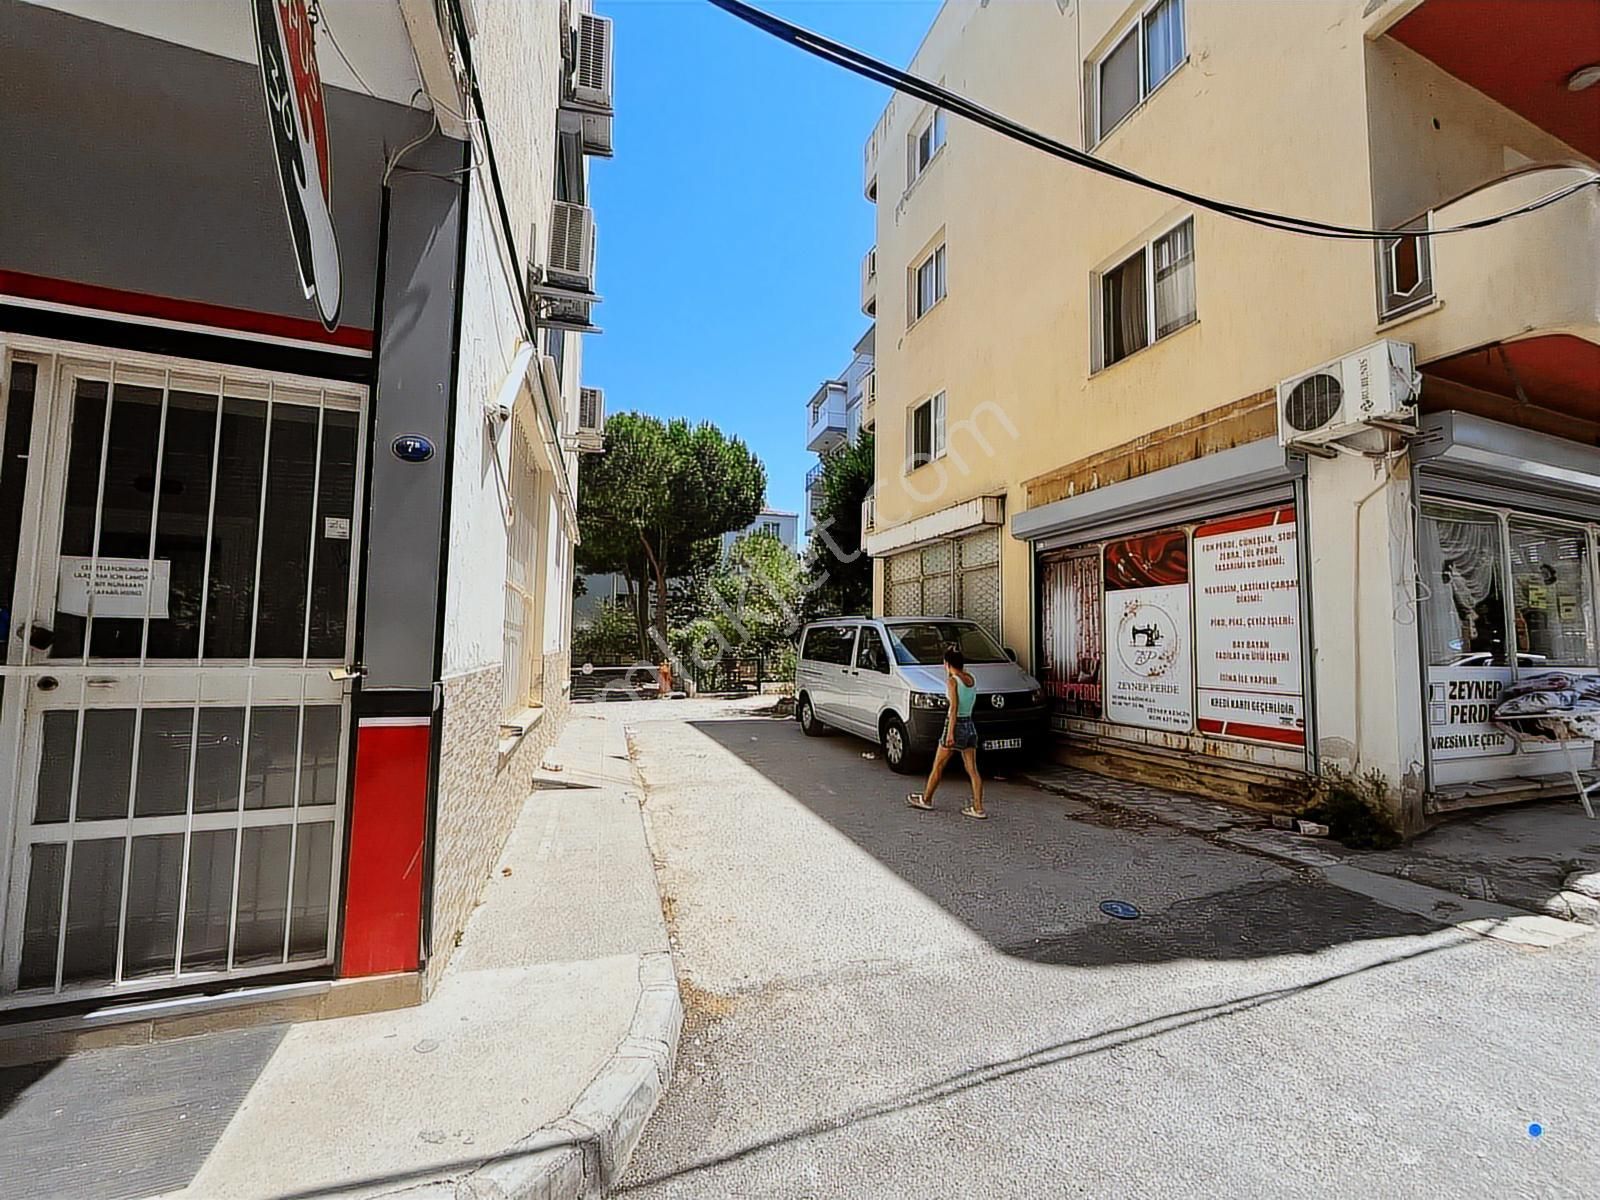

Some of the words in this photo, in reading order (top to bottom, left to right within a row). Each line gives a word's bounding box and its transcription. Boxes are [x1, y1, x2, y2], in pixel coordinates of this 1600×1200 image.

[1117, 681, 1149, 692] ZEYNEP
[1150, 683, 1180, 694] PERDE
[1448, 680, 1503, 700] ZEYNEP
[1450, 703, 1497, 724] PERDE
[1468, 734, 1480, 748] VE
